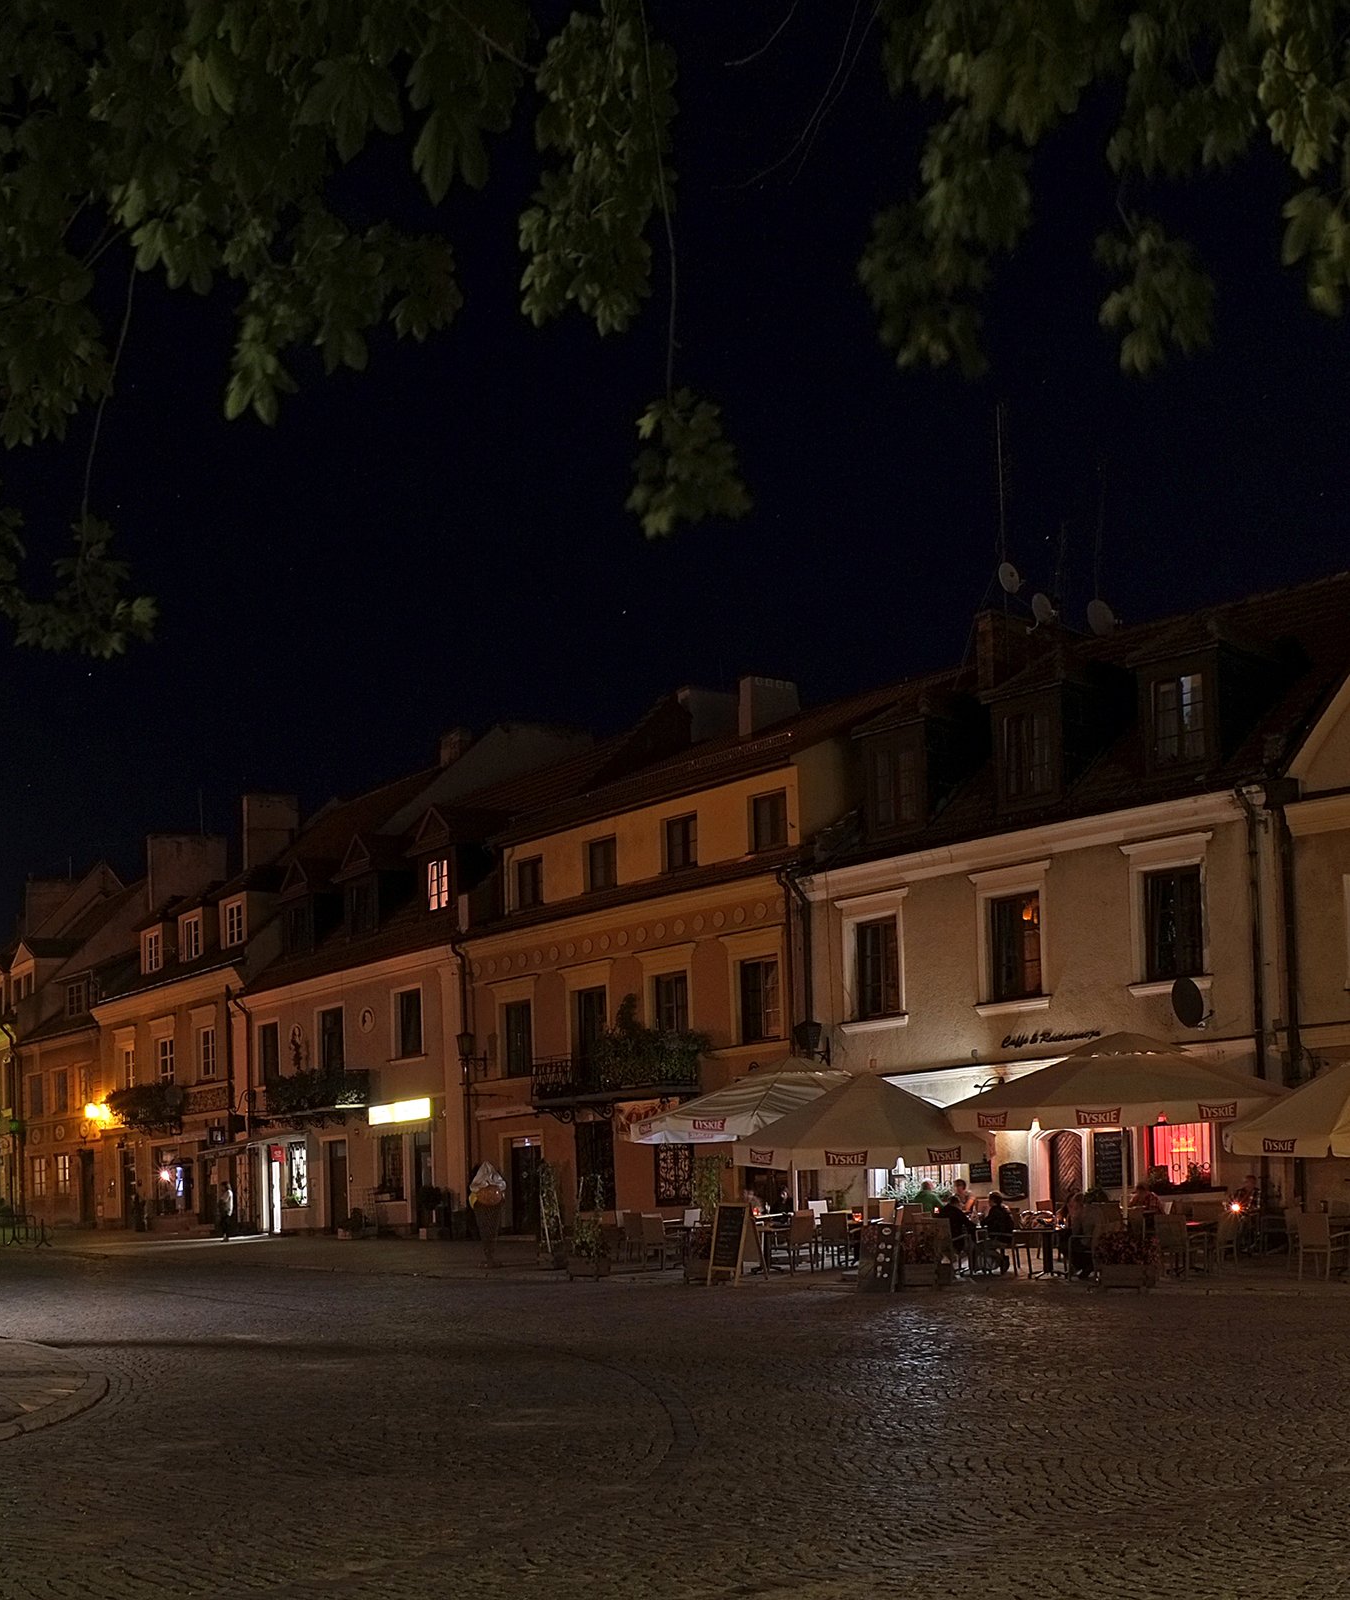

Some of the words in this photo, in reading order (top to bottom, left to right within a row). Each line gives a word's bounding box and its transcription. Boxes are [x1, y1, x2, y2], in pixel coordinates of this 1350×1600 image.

[1077, 1109, 1119, 1124] TYSKIE
[1199, 1104, 1236, 1118] TYSKIE
[693, 1119, 724, 1131] TYSKIE
[978, 1113, 1006, 1127] TYSKIE
[1264, 1140, 1294, 1151] TYSKIE
[827, 1152, 866, 1165] TYSKIE
[929, 1148, 960, 1162] TYSKIE
